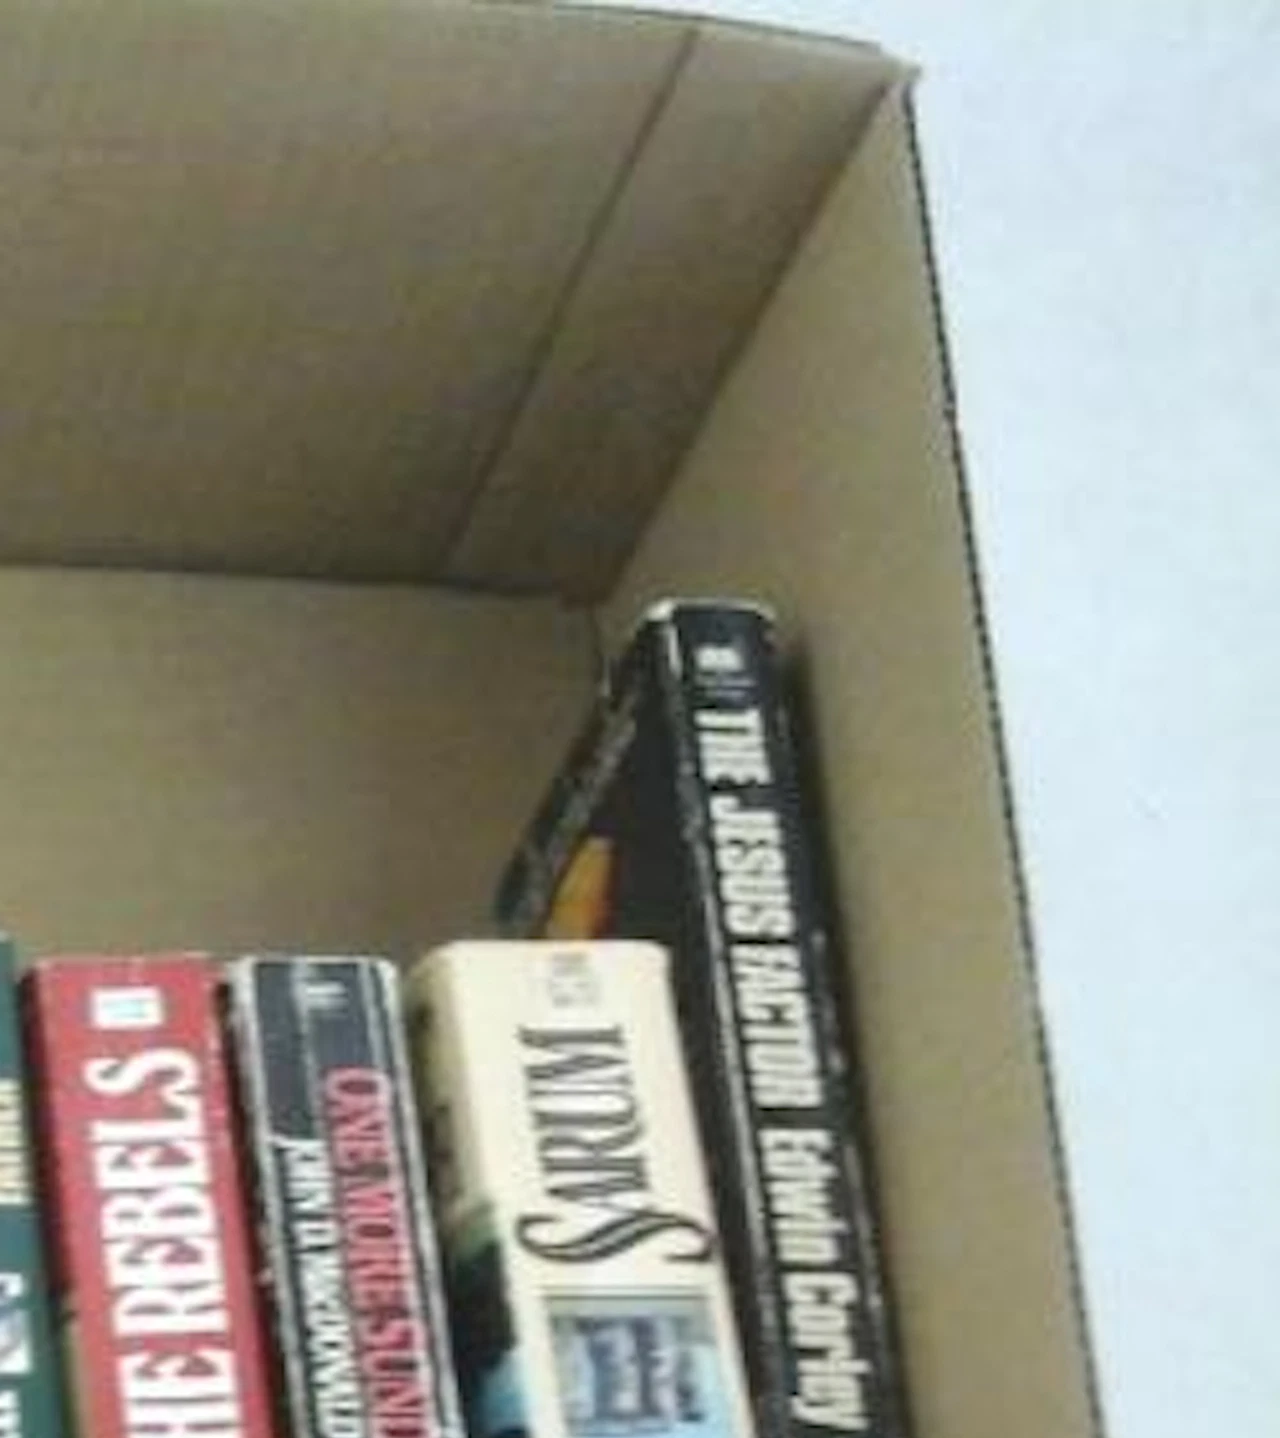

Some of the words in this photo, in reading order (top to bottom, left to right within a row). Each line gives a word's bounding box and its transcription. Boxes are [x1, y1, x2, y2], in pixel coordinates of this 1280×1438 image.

[694, 708, 772, 785] THE
[708, 794, 797, 937] JESUS
[729, 942, 828, 1109] FACTOR
[266, 1135, 338, 1212] JOHN
[324, 1066, 395, 1168] ONE
[80, 1048, 231, 1337] REBELS
[340, 1175, 421, 1307] MORE
[756, 1127, 849, 1266] Edwin
[780, 1270, 874, 1431] Corley
